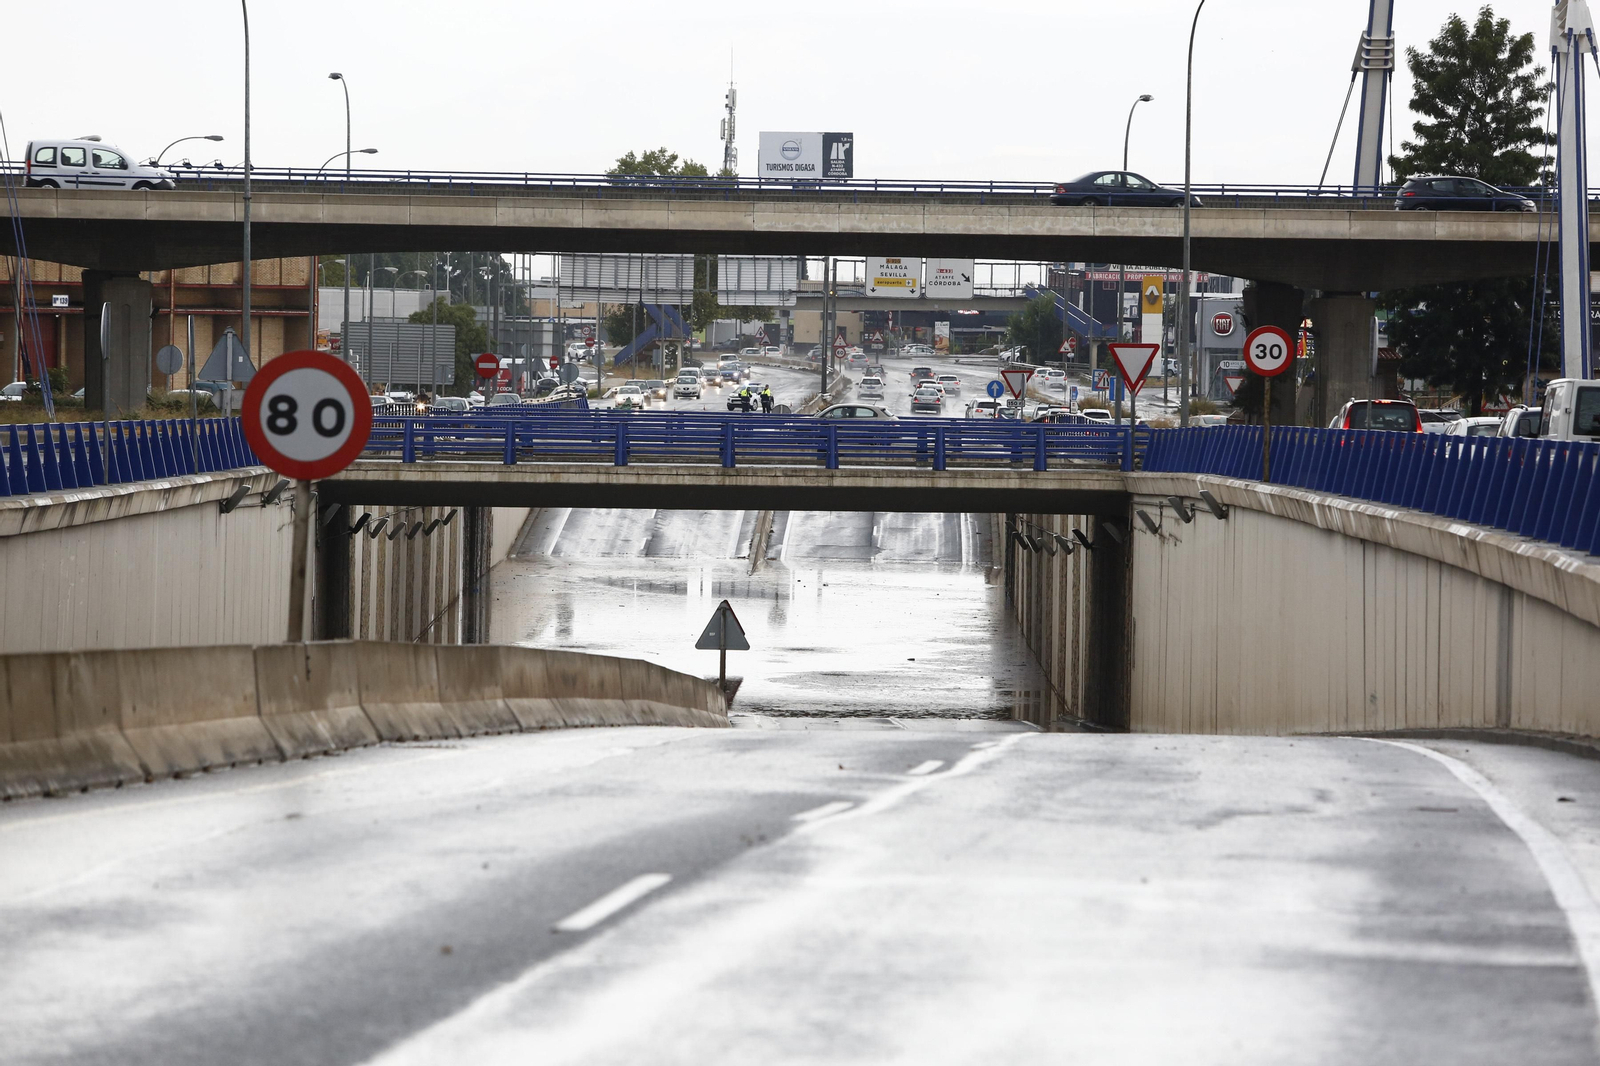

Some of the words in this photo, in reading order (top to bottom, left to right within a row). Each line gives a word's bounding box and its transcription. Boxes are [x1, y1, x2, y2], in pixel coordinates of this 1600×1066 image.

[766, 163, 794, 172] TURISMOS
[795, 163, 816, 172] DIGASA
[1216, 319, 1230, 330] FIAT
[1255, 344, 1282, 360] 30
[266, 394, 346, 438] 80
